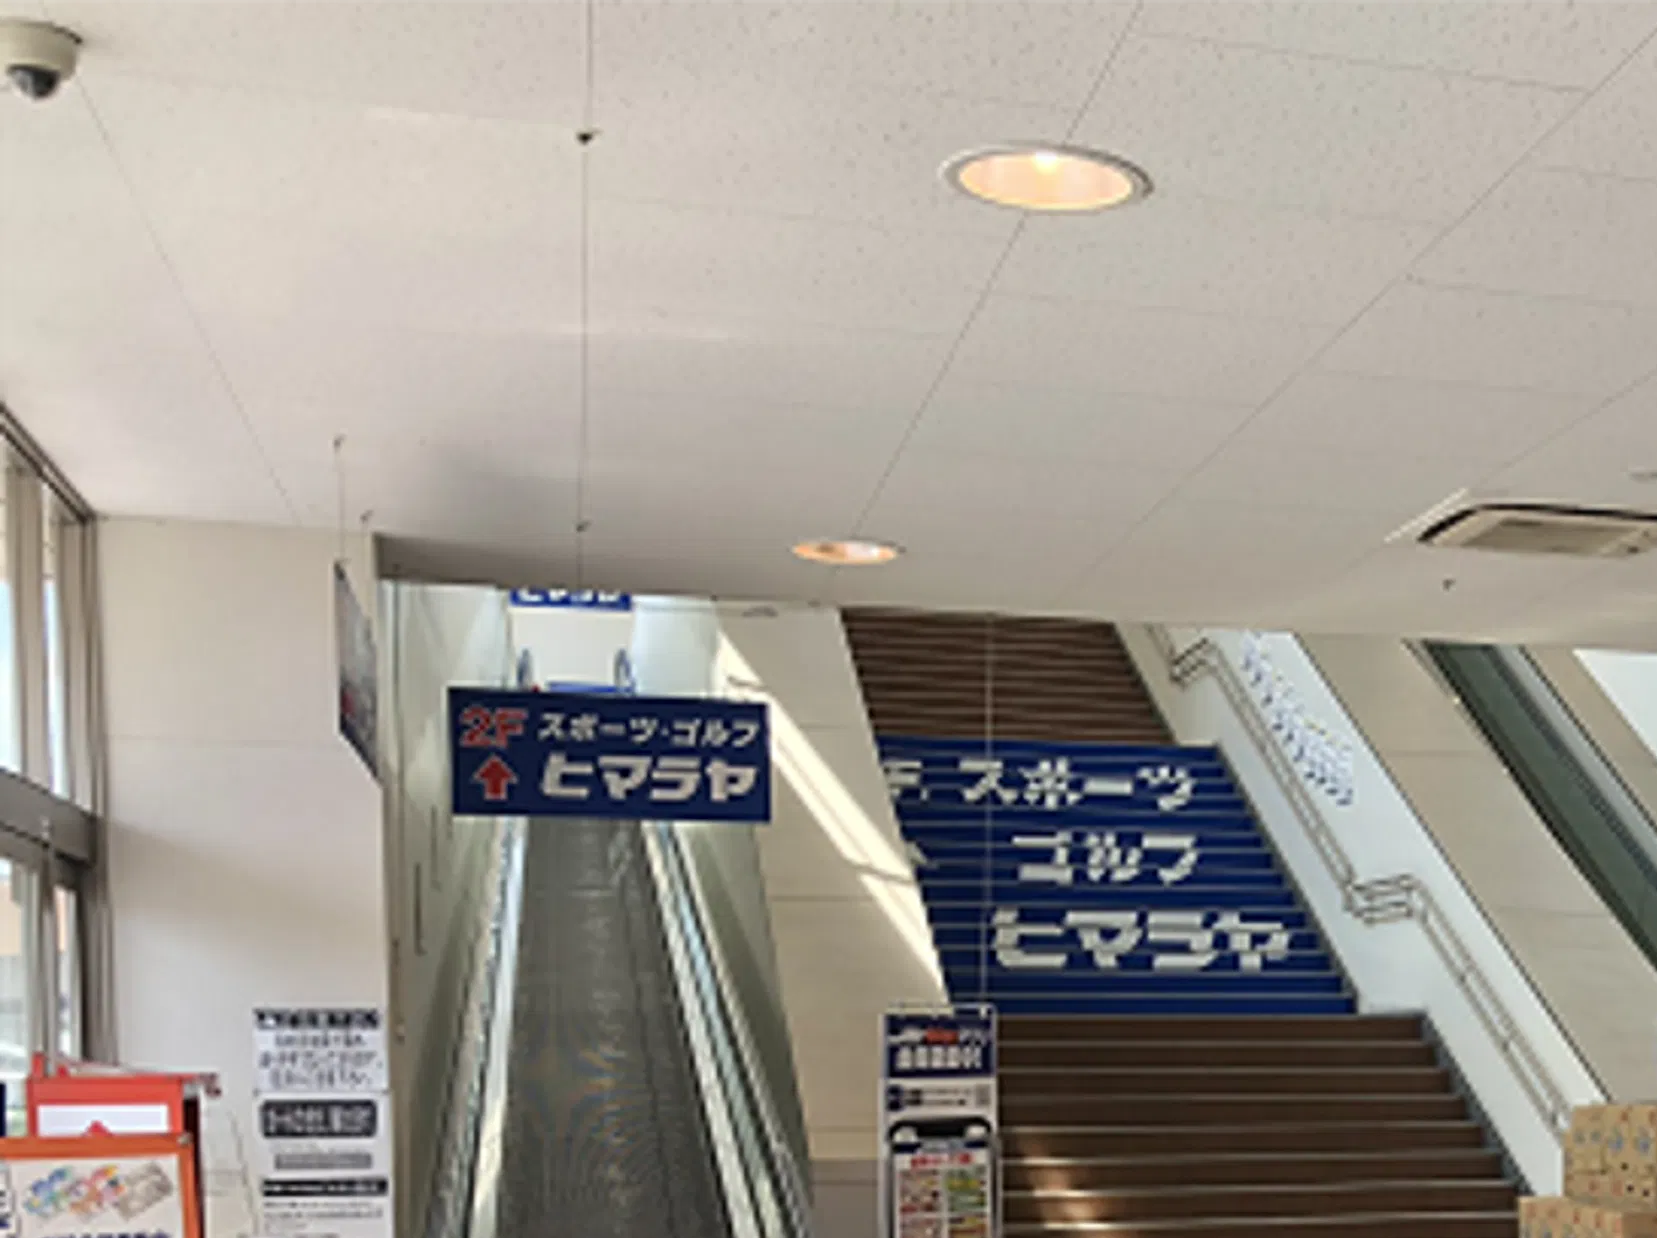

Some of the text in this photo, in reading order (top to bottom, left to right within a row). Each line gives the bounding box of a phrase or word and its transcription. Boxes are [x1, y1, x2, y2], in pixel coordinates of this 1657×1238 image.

[537, 712, 760, 748] スポーツ・ゴルフ
[540, 752, 759, 803] ヒマラヤ
[959, 757, 1198, 811] スポーツ
[1011, 830, 1198, 886] ゴルフ
[990, 908, 1290, 973] ヒマラヤ
